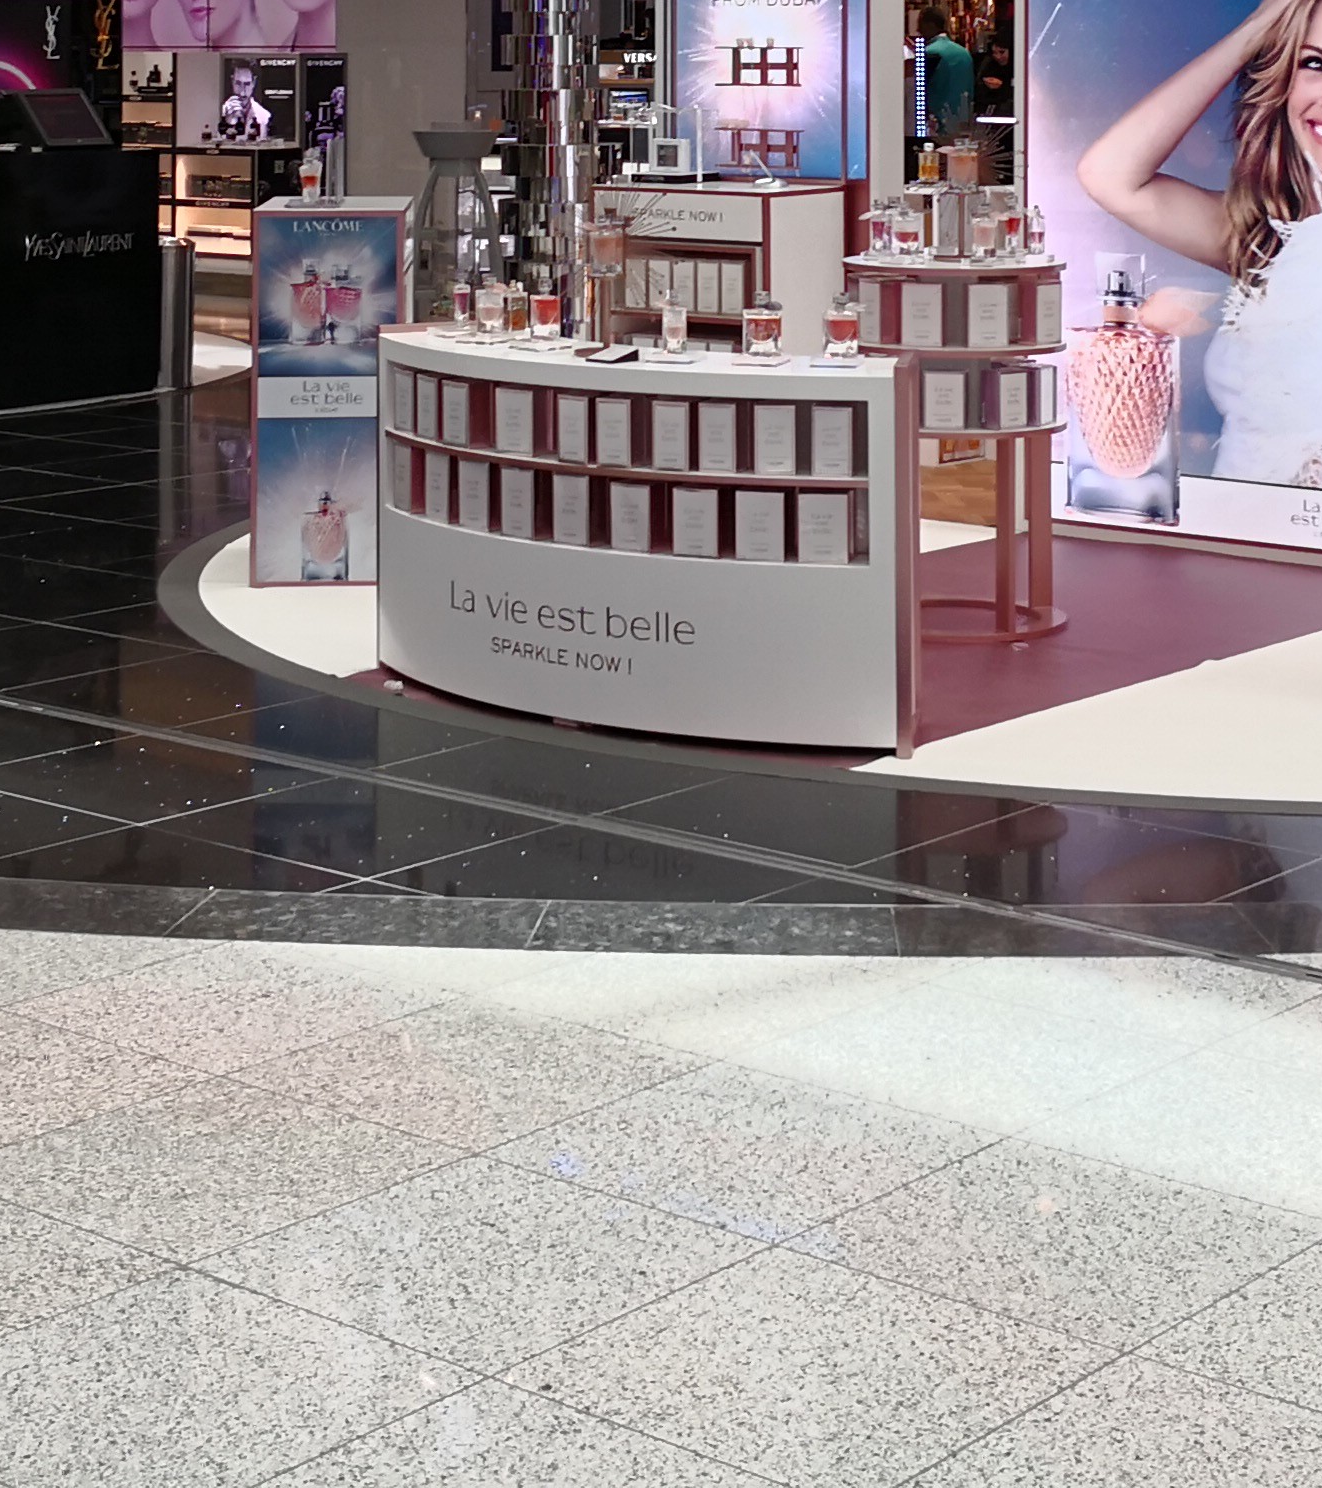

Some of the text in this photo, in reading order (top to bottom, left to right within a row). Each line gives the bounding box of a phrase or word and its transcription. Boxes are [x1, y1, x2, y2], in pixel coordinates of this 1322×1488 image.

[688, 209, 717, 223] NOW
[292, 218, 365, 233] LANCÔME
[302, 380, 351, 393] La vie
[290, 392, 364, 406] est belle
[1302, 498, 1321, 513] La
[1290, 512, 1320, 528] est
[449, 579, 696, 646] La vie est belle
[490, 635, 569, 667] SPARKLE
[575, 651, 623, 674] NOW
